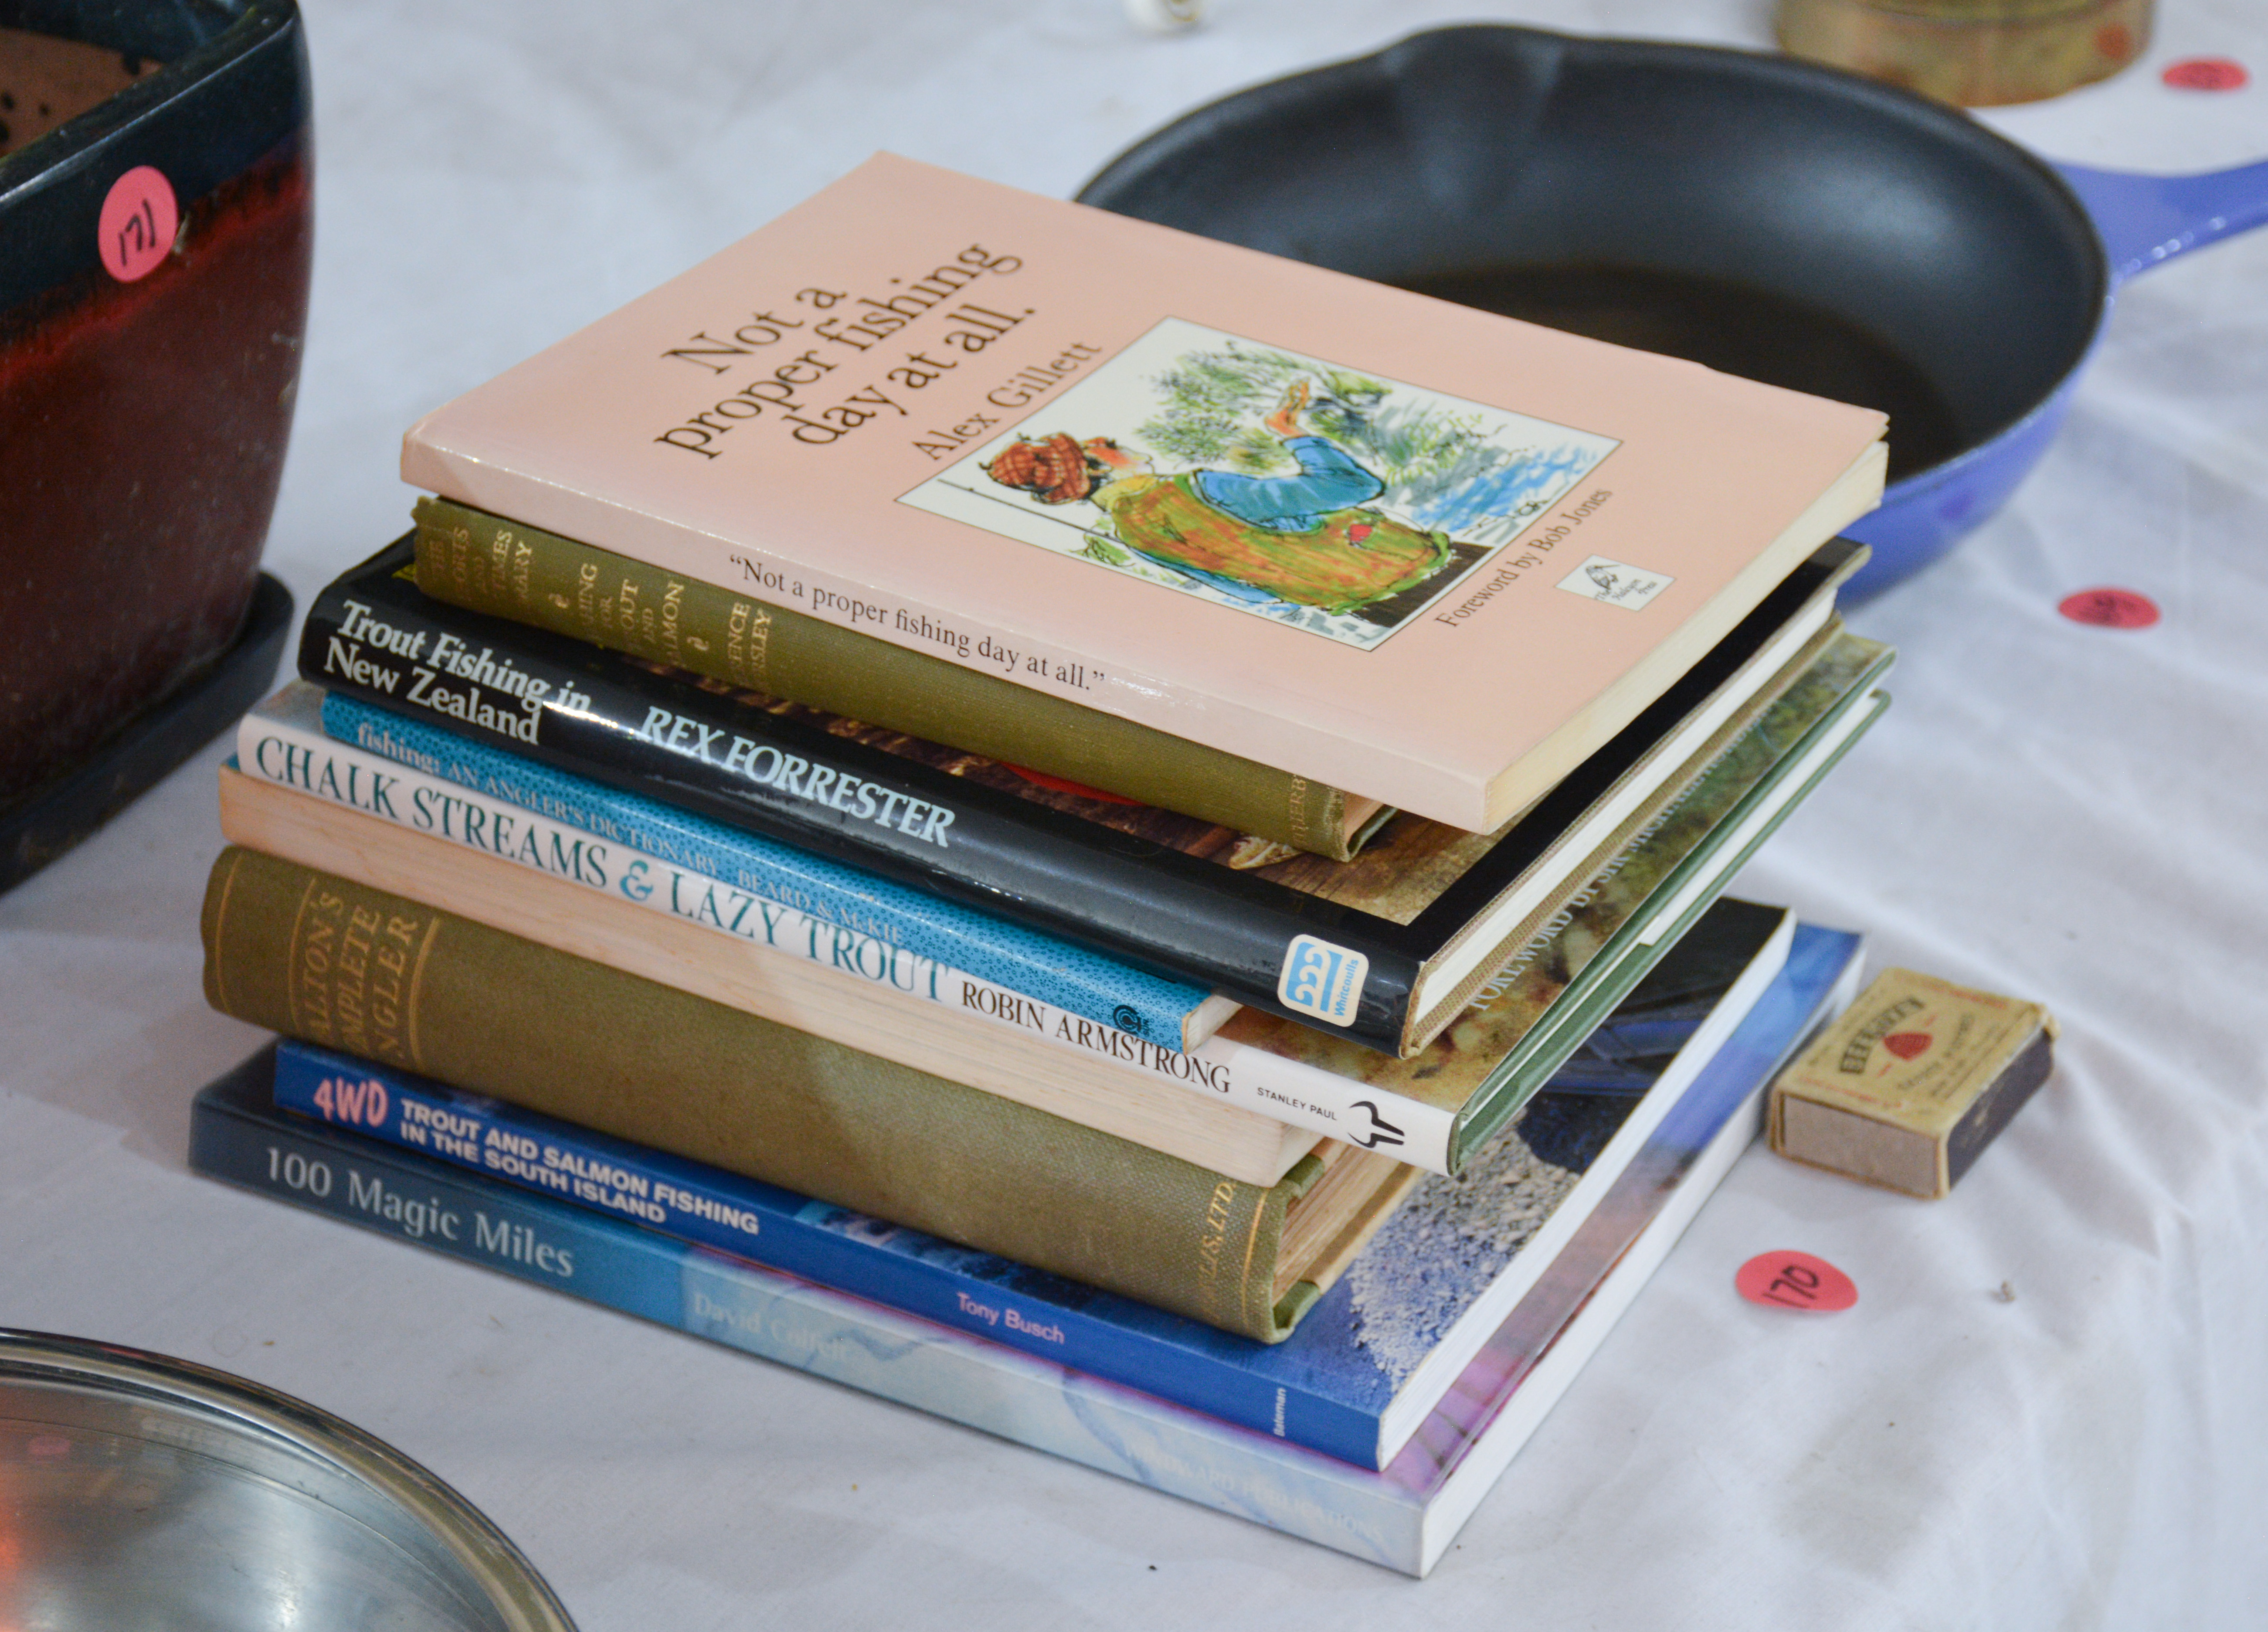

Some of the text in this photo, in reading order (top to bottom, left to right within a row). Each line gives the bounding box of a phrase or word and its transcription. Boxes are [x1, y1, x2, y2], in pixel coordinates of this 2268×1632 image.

[119, 199, 156, 266] 171
[654, 244, 1023, 460] proper fishing
[660, 287, 847, 375] Not a
[782, 304, 1036, 448] day at all.
[912, 341, 1103, 461] Alex Gillett
[1434, 488, 1613, 627] Foreword by Bob Jones
[337, 599, 591, 713] Trout Fishing in
[792, 581, 804, 597] a
[813, 587, 888, 624] proper
[895, 609, 971, 656] fishing
[978, 636, 1020, 672] day
[1027, 652, 1048, 675] at
[323, 636, 542, 746] New Zealand
[640, 706, 955, 848] REX FORRESTER
[449, 762, 479, 785] AN
[738, 870, 810, 908] BEARD
[817, 901, 832, 918] &
[256, 736, 1337, 1121] CHALK STREAMS & LAZY TROUT ROBIN ARMSTRONG STANLEY PAUL
[1334, 958, 1359, 1017] Whitcoulls
[313, 1078, 388, 1127] 4WD
[266, 1146, 332, 1197] 100
[348, 1170, 460, 1241] Magic
[474, 1212, 574, 1278] Miles
[400, 1122, 666, 1224] IN THE SOUTH ISLAND
[401, 1099, 759, 1235] TROUT AND SALMON FISHING
[956, 1292, 1066, 1344] Tony Busch
[1762, 1265, 1819, 1309] 170
[1273, 1387, 1286, 1437] Bateman
